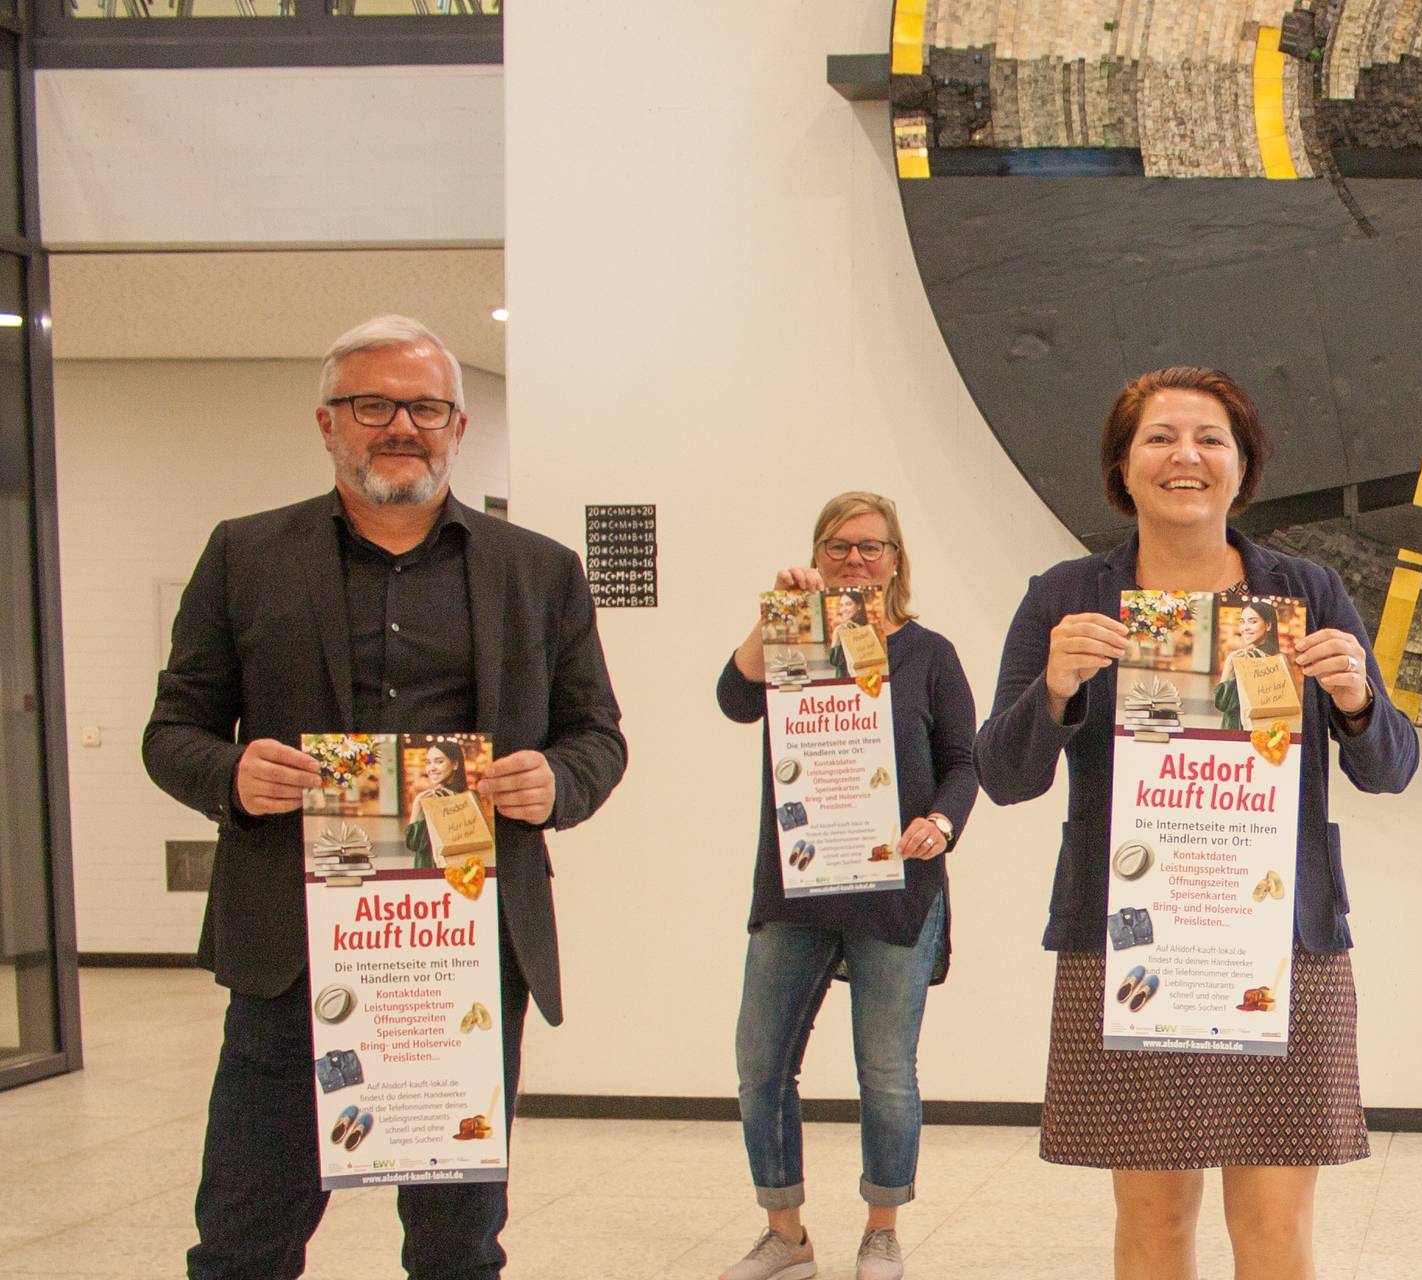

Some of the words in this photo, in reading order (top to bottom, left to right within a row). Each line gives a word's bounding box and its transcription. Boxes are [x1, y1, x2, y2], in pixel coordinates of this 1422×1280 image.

[798, 693, 860, 715] Alsdorf
[785, 714, 830, 735] kauft
[834, 711, 877, 731] lokal
[1158, 752, 1255, 783] Alsdorf
[1135, 779, 1204, 809] kauft
[1210, 782, 1275, 812] lokal
[1135, 818, 1152, 829] Die
[1156, 819, 1225, 832] Internetseite
[1228, 823, 1246, 833] mit
[1250, 823, 1277, 834] Ihren
[1159, 832, 1207, 844] Händlern
[1211, 837, 1228, 845] vor
[1173, 849, 1236, 861] Kontaktdaten
[1160, 862, 1248, 876] Leistungsspektrum
[1168, 875, 1239, 889] Öffnungszeiten
[1170, 889, 1236, 901] Speisenkarten
[354, 892, 451, 921] Alsdorf
[1152, 901, 1181, 913] Bring-
[1184, 903, 1201, 912] und
[1204, 903, 1252, 915] Holservice
[333, 922, 402, 950] kauft
[409, 919, 475, 948] lokal
[334, 962, 352, 972] Die
[356, 959, 426, 971] Internetseite
[430, 958, 448, 968] mit
[451, 958, 479, 967] Ihren
[360, 973, 409, 984] Händlern
[413, 974, 431, 982] vor
[375, 987, 441, 999] Kontaktdaten
[363, 1000, 454, 1014] Leistungsspektrum
[373, 1013, 445, 1026] Öffnungszeiten
[376, 1026, 444, 1039] Speisenkarten
[360, 1041, 388, 1052] Bring-
[391, 1040, 409, 1049] und
[412, 1038, 461, 1048] Holservice
